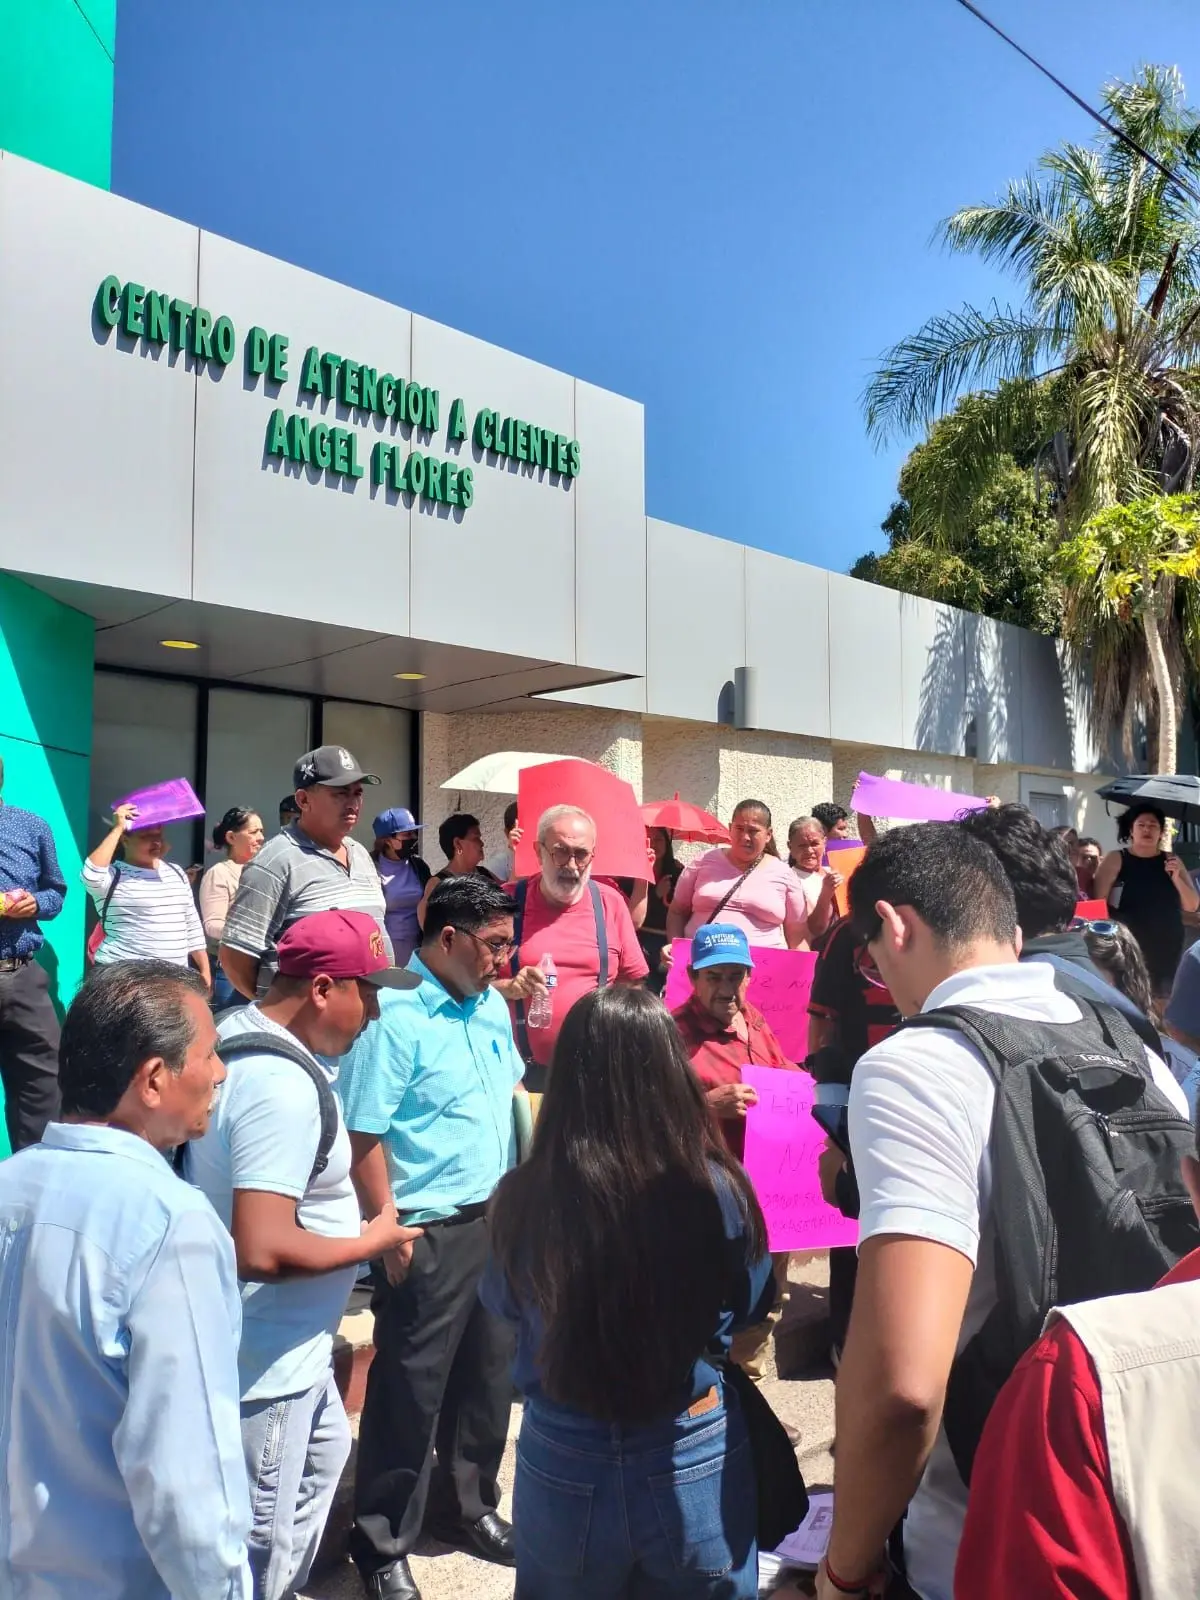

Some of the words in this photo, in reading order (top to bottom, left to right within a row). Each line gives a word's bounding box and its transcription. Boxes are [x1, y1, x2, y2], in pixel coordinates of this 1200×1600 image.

[96, 274, 236, 365] CENTRO
[248, 326, 289, 383] DE
[302, 345, 440, 433] ATENCION
[449, 398, 468, 441] A
[473, 408, 581, 478] CLIENTES
[268, 408, 364, 479] ANGEL
[371, 441, 474, 508] FLORES
[1074, 1053, 1127, 1067] Targus
